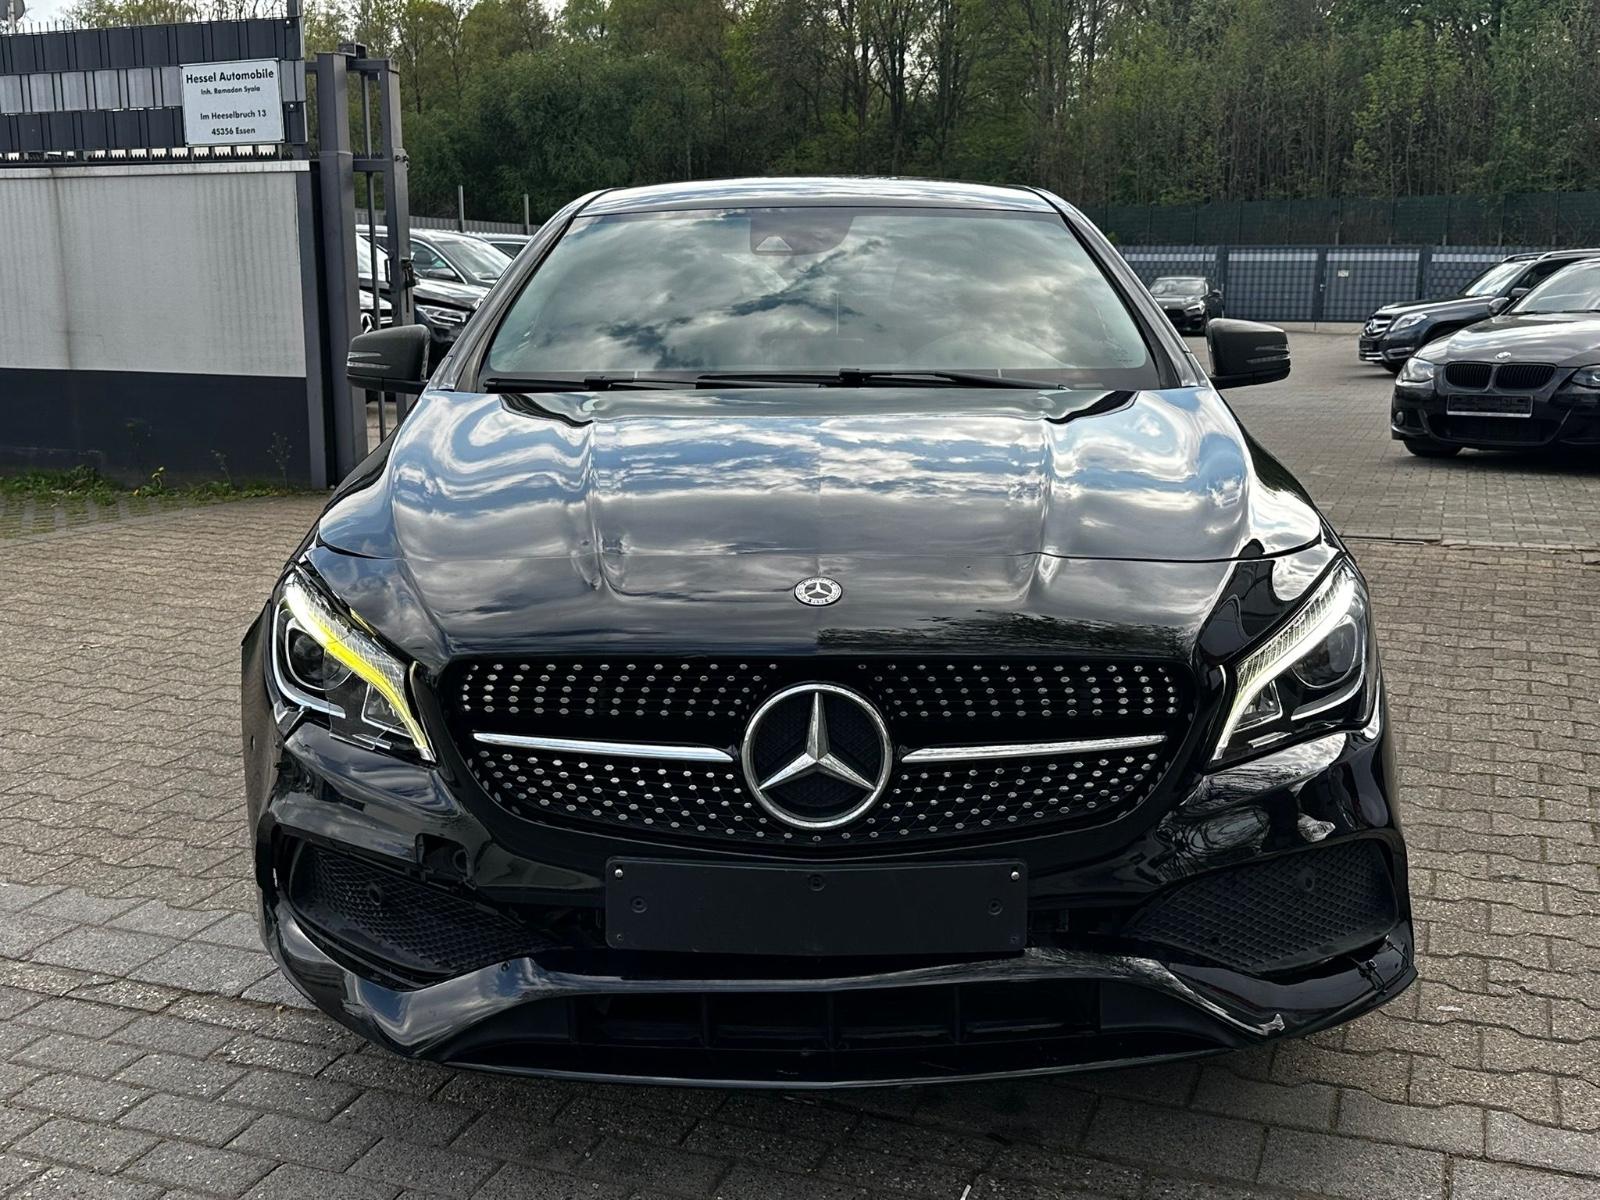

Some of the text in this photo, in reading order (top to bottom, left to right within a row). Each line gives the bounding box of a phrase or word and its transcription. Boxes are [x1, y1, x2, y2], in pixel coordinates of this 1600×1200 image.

[186, 68, 275, 84] Hessel Automobile
[211, 110, 256, 120] Heeselbruch
[257, 109, 267, 118] 13
[211, 127, 256, 136] 45356 Essen
